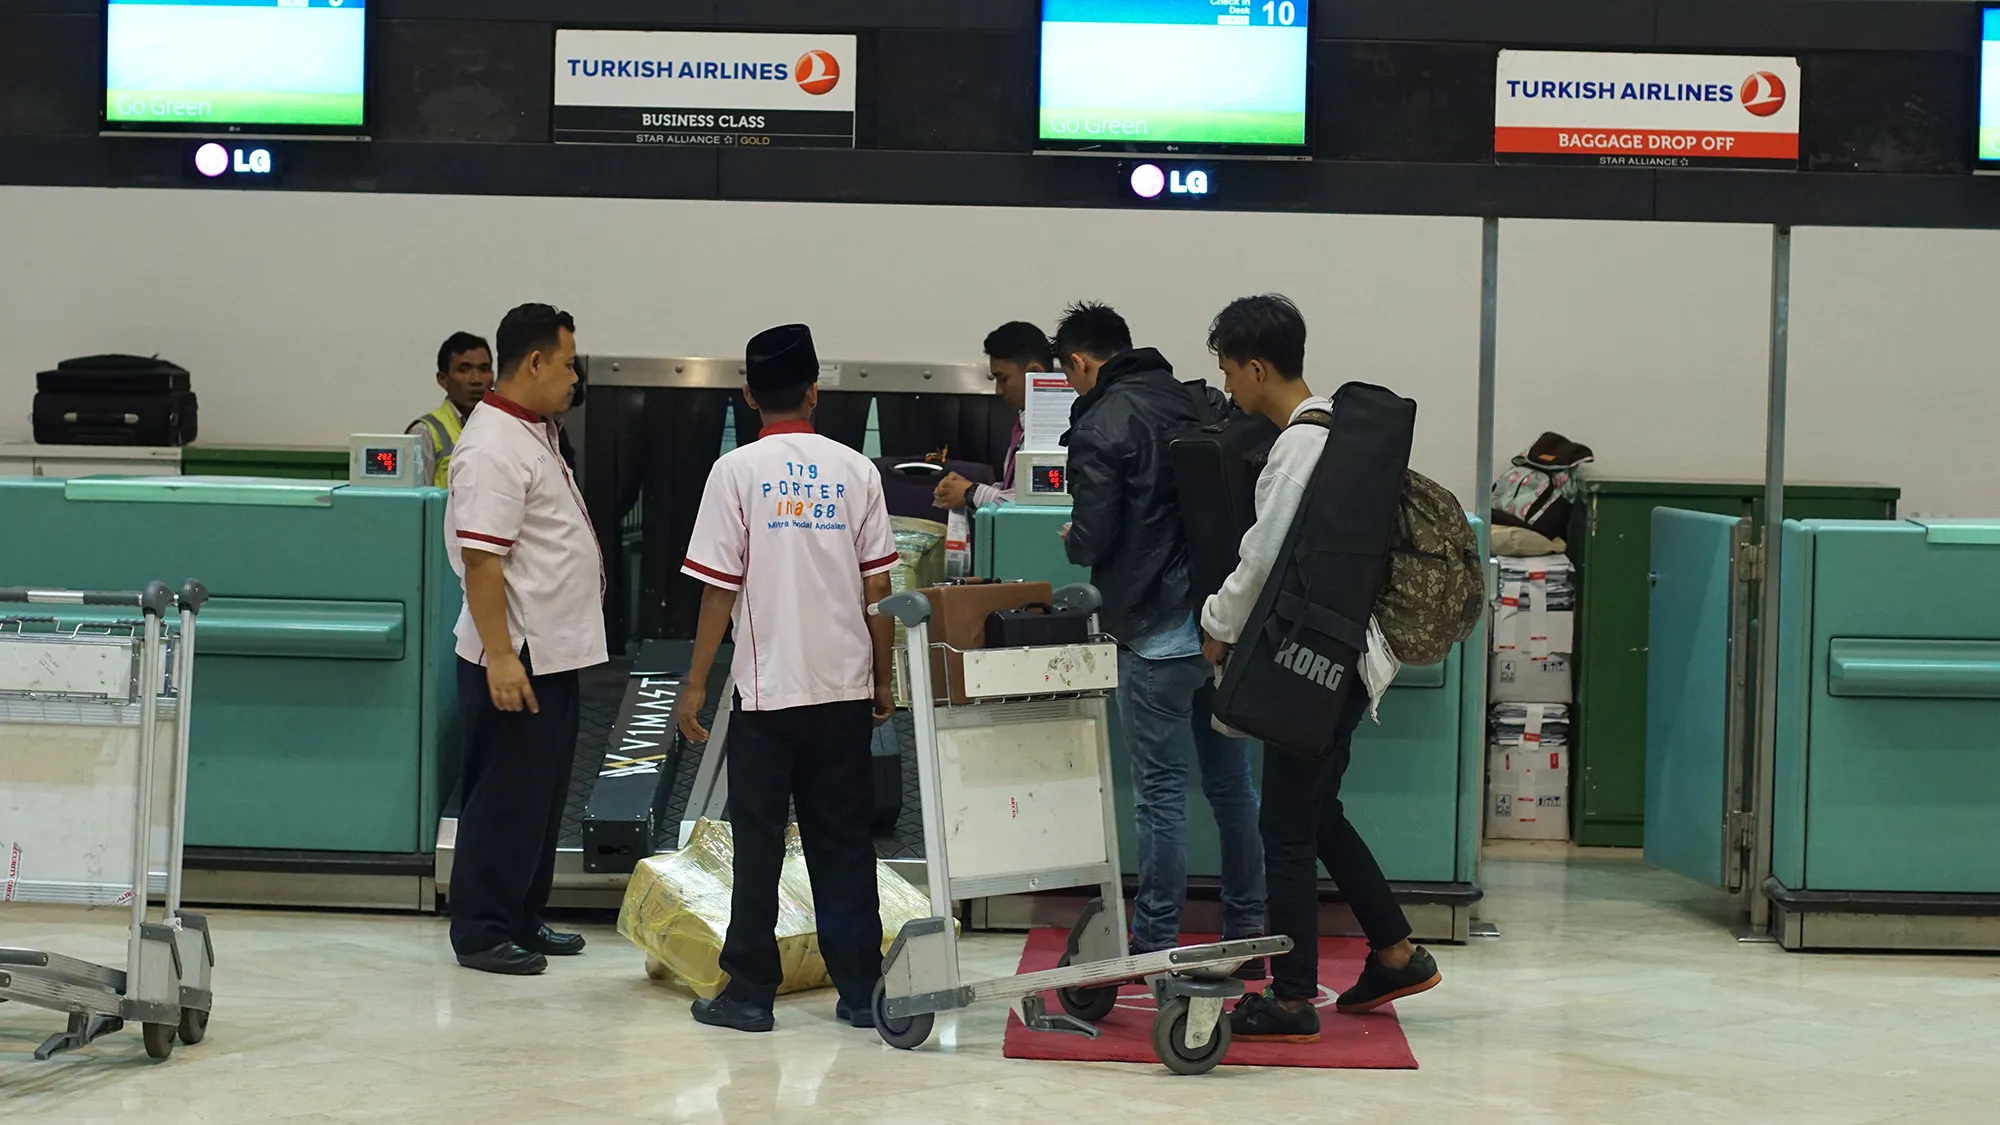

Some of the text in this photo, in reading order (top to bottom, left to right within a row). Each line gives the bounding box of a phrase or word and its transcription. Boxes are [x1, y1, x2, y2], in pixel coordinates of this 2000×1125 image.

[1229, 6, 1250, 14] Desk
[1262, 0, 1295, 25] 10
[567, 59, 788, 81] TURKISH AIRLINES
[1507, 80, 1733, 102] TURKISH AIRLINES
[117, 95, 211, 117] Go Green
[641, 113, 766, 129] BUSINESS CLASS
[1050, 113, 1149, 135] Go Green
[636, 134, 770, 146] STAR ALLIANCE GOLD
[1558, 133, 1735, 151] BAGGAGE DROP OFF
[233, 148, 271, 173] LG
[1599, 156, 1678, 167] STAR ALLIANCE
[1169, 170, 1208, 194] LG
[786, 461, 818, 479] 179
[762, 480, 845, 498] PORTER
[768, 519, 789, 530] Mitra
[815, 522, 846, 531] Andalan
[1273, 637, 1345, 692] KORG
[10, 842, 18, 879] ECURITY
